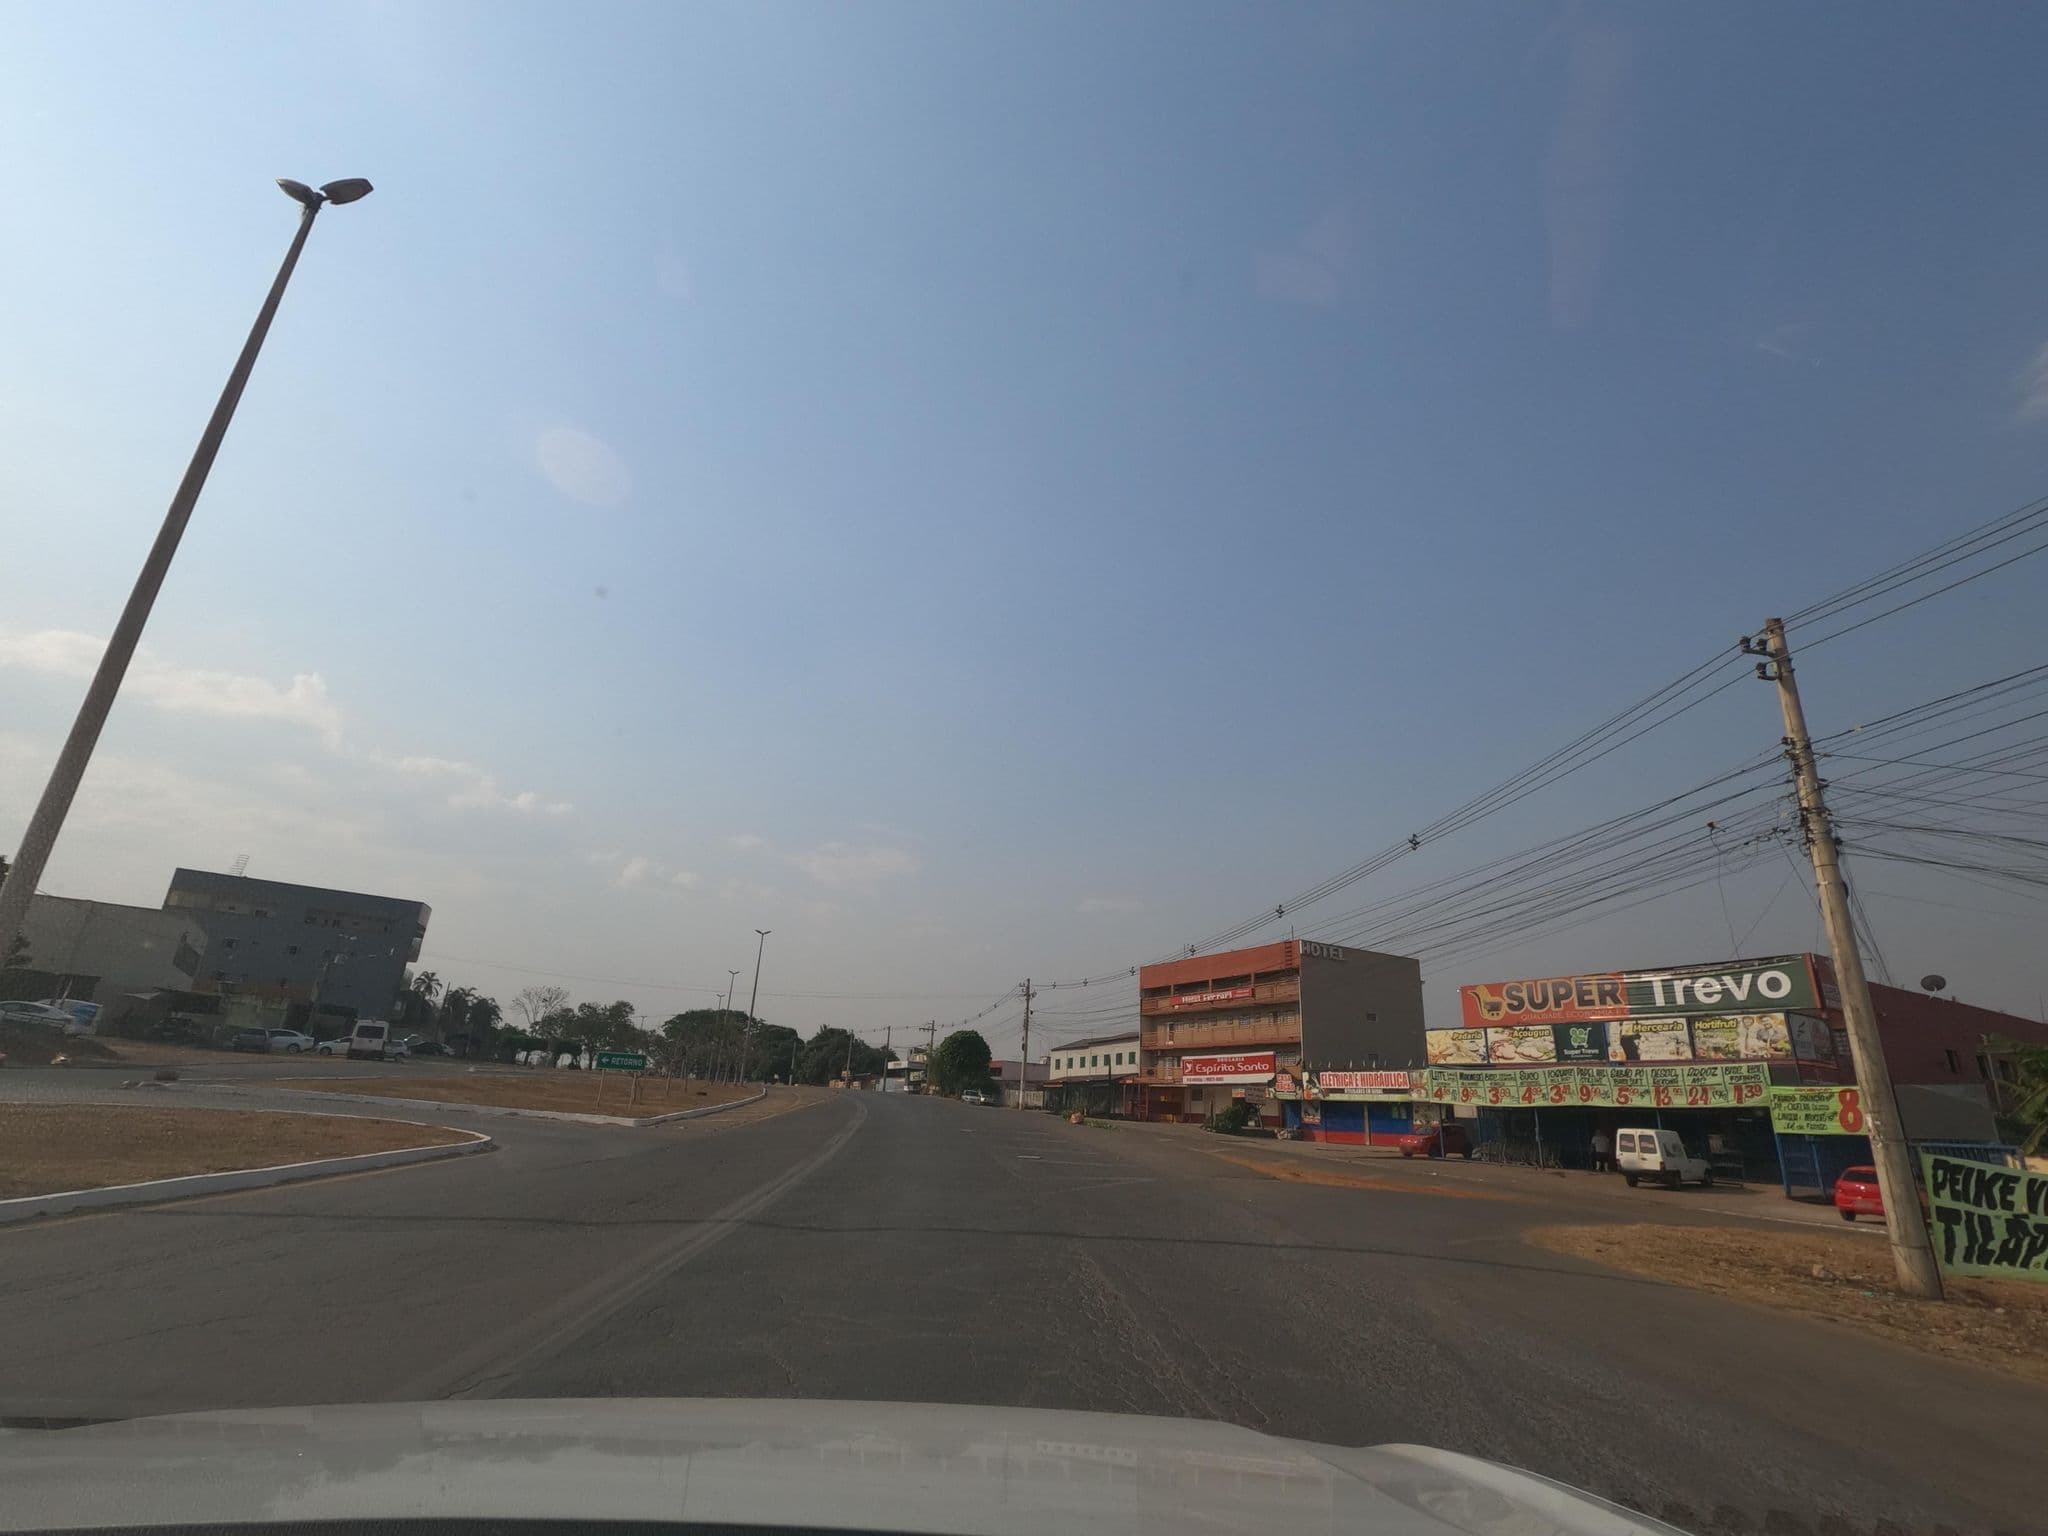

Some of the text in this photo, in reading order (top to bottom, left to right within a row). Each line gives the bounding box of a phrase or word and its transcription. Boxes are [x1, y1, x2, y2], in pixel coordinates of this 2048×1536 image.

[1301, 941, 1345, 961] HOTEL
[1503, 975, 1625, 1015] SUPER
[1651, 969, 1793, 1007] Trevo
[1632, 1021, 1685, 1033] Mercearia
[1694, 1017, 1739, 1032] Hortifruti
[1452, 1031, 1483, 1041] Padaria
[1512, 1028, 1551, 1040] Açougue
[611, 1057, 643, 1067] RETORNO
[1195, 1061, 1270, 1075] Espírito Santo
[1519, 1070, 1540, 1082] SUCO
[1687, 1066, 1719, 1077] ARROZ
[1321, 1070, 1409, 1088] ELÉTRICA E HIDRÁULICA
[1838, 1087, 1865, 1133] 8
